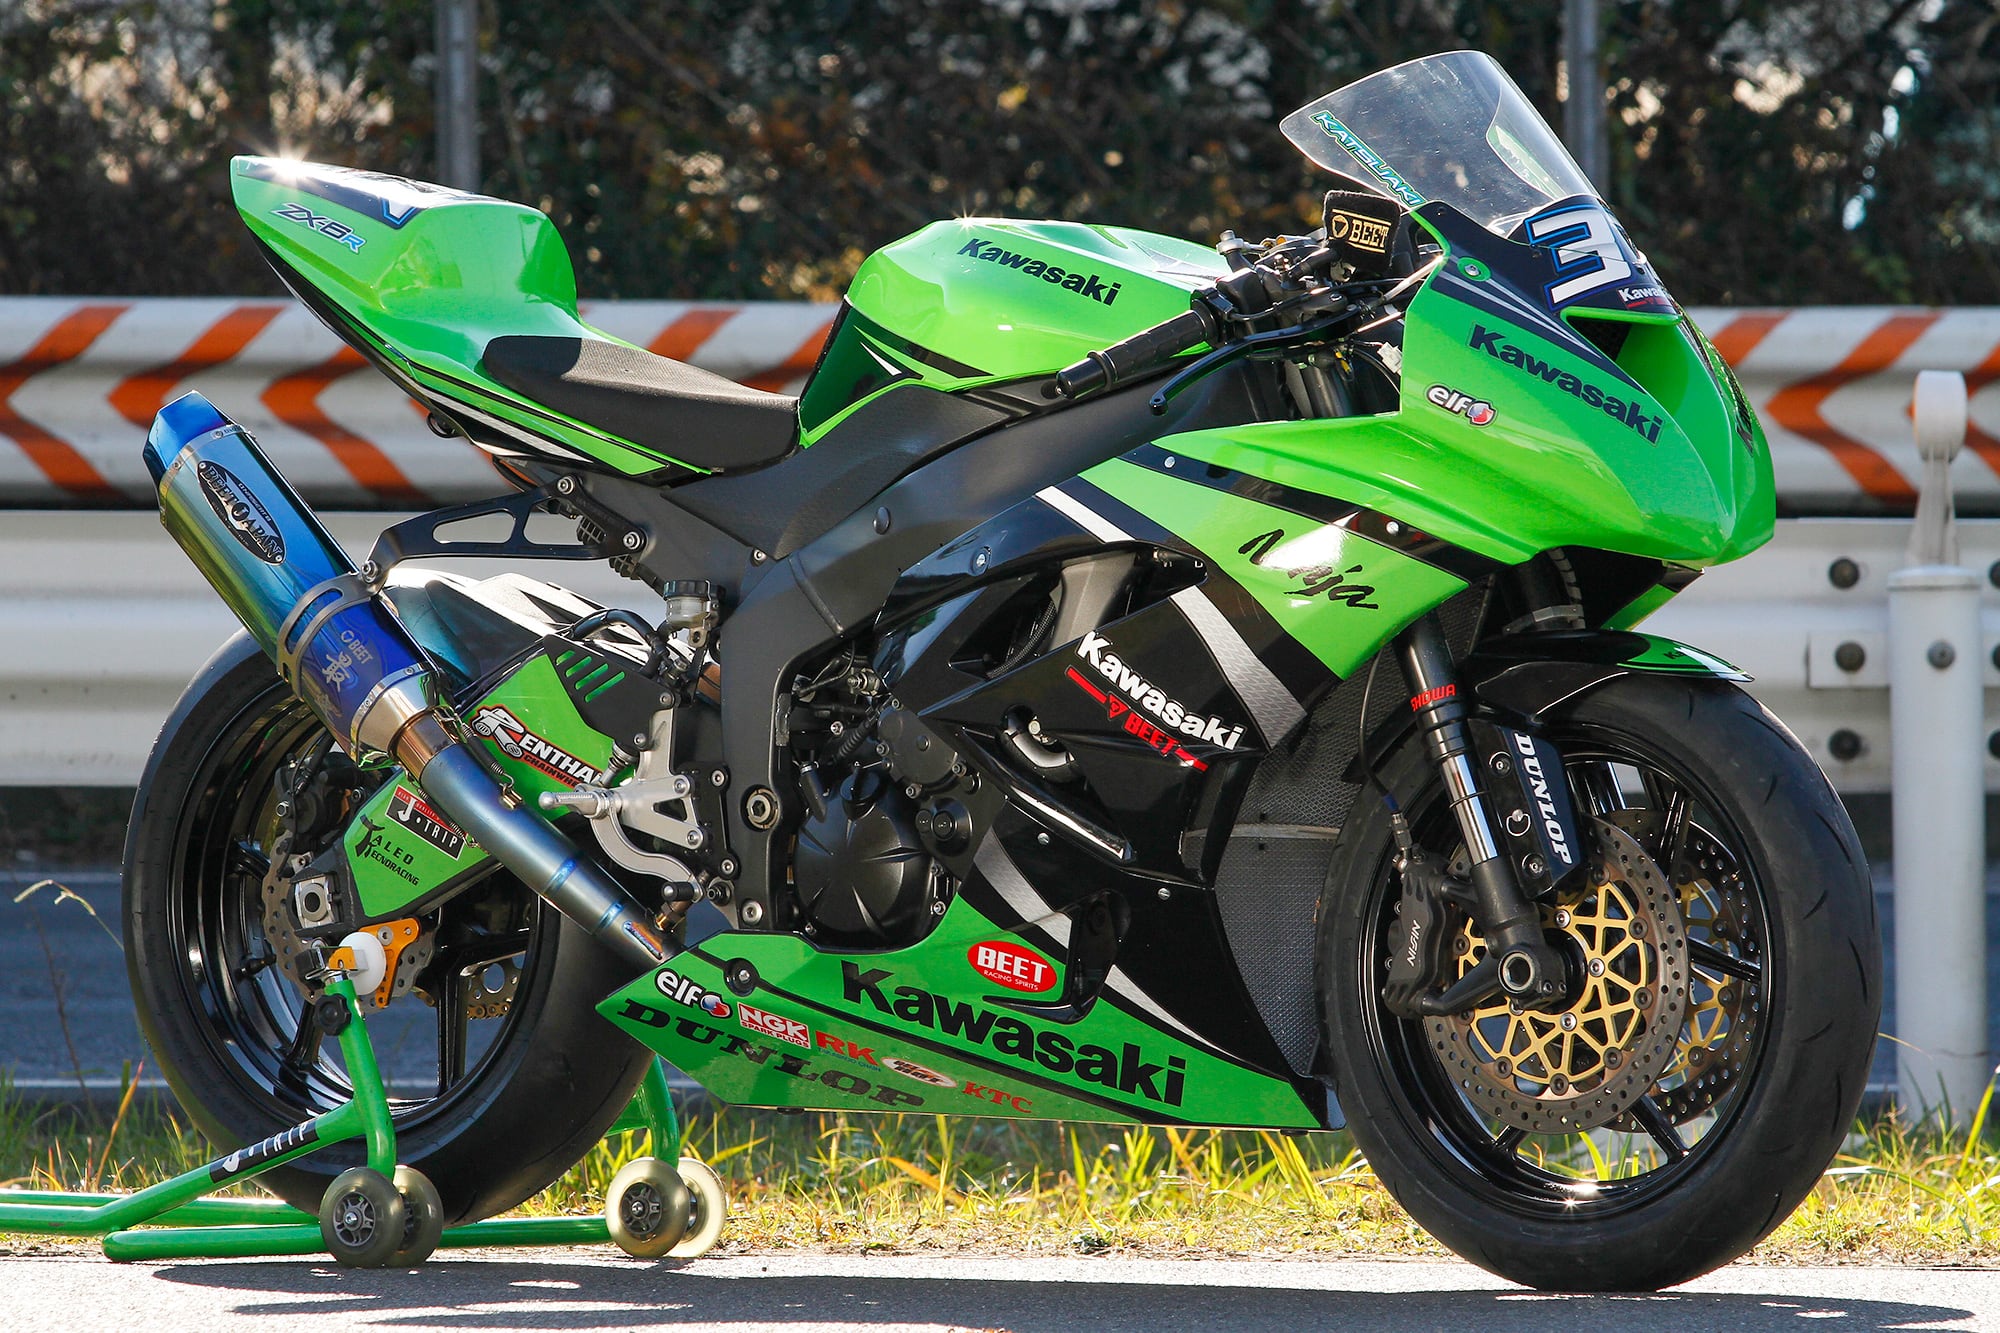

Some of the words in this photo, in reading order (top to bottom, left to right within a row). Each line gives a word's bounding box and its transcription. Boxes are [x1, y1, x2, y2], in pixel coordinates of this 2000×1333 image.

[1313, 112, 1424, 206] KATSUAKI
[272, 203, 366, 253] ZX-6R
[1349, 219, 1390, 248] BEET
[957, 238, 1122, 306] Kawasaki
[1526, 205, 1636, 310] 3
[1427, 385, 1474, 413] elf
[1469, 324, 1664, 445] Kawasaki
[348, 639, 374, 664] BEET
[1077, 631, 1244, 750] Kawasaki
[1410, 684, 1456, 712] SHOWA
[1124, 712, 1181, 755] BEET
[1513, 732, 1573, 864] DUNLOP
[977, 945, 1048, 983] BEET
[983, 969, 1013, 983] RACING
[1014, 978, 1039, 991] SPIRITS
[656, 971, 703, 1005] elf
[739, 1003, 808, 1041] NGK
[741, 1021, 773, 1037] SPARK
[772, 1031, 810, 1048] PLUGS
[841, 960, 1187, 1107] Kawasaki
[617, 998, 925, 1106] DUNLOP
[815, 1030, 879, 1066] RK
[962, 1081, 1033, 1113] KTC
